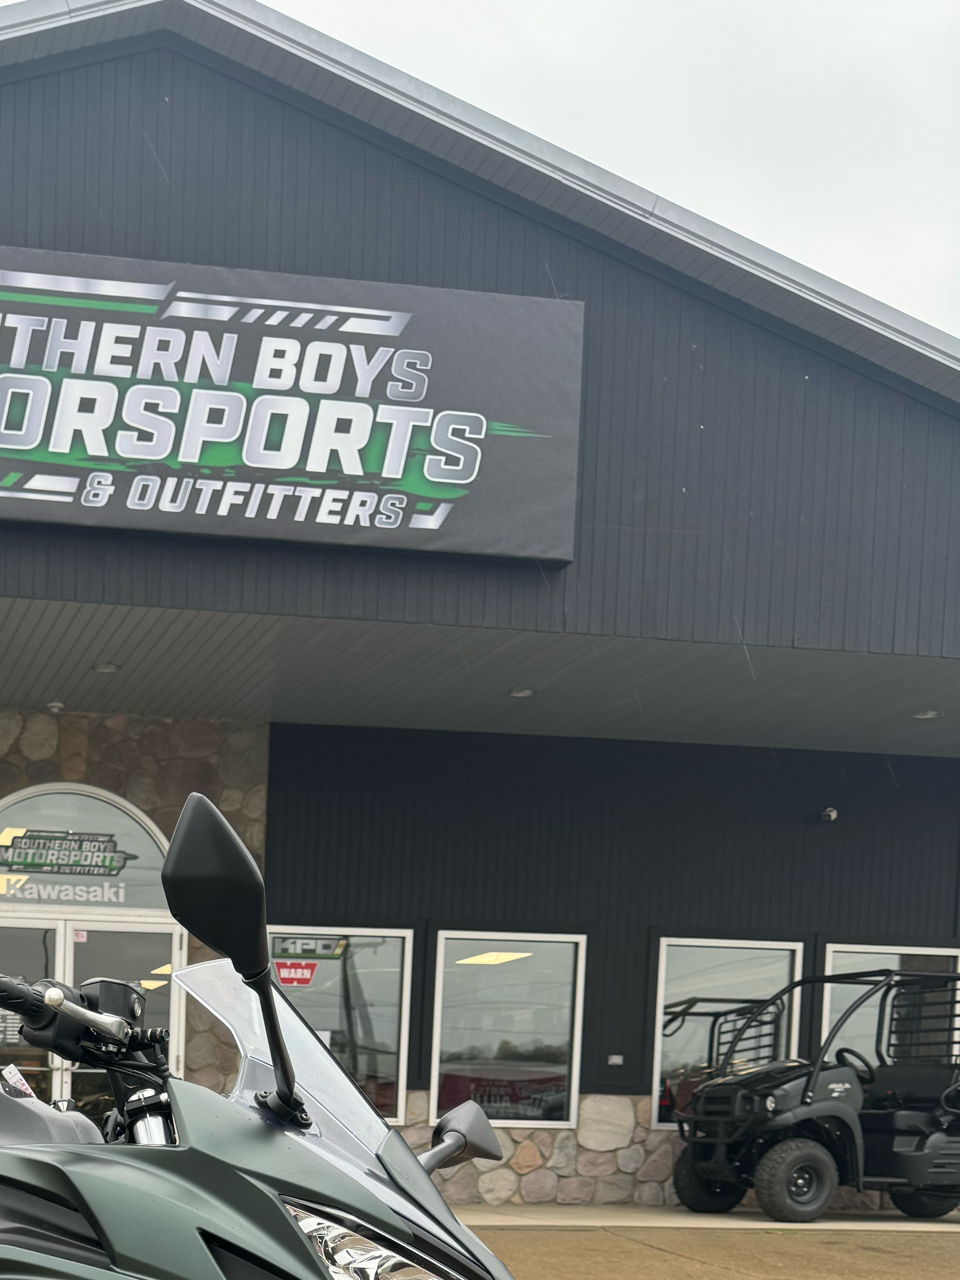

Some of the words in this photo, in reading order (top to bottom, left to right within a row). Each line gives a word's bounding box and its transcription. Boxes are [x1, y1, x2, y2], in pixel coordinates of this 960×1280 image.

[252, 337, 433, 402] BOYS
[80, 472, 114, 507] &
[125, 475, 408, 530] OUTFITTERS
[13, 837, 80, 850] SOUTHERN
[82, 840, 115, 853] BOYS
[5, 878, 126, 903] Kawasaki
[279, 967, 312, 979] WARN
